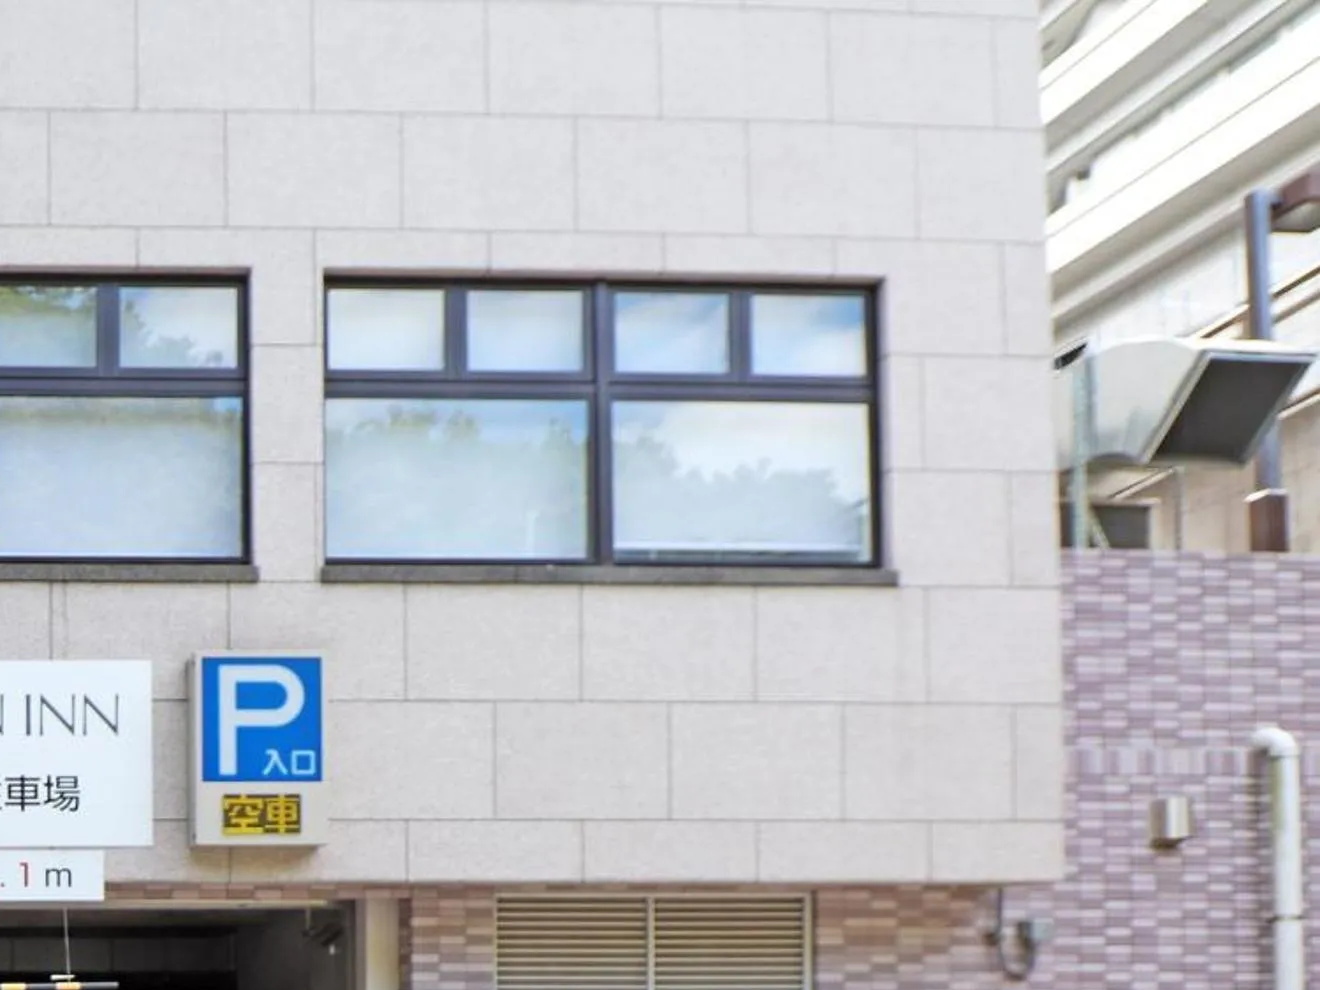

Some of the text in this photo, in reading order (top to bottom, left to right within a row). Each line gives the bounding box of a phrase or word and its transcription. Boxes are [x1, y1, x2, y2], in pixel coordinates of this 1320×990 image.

[25, 694, 119, 736] INN
[218, 664, 305, 776] P
[262, 749, 316, 776] 入口
[223, 794, 301, 836] 空車
